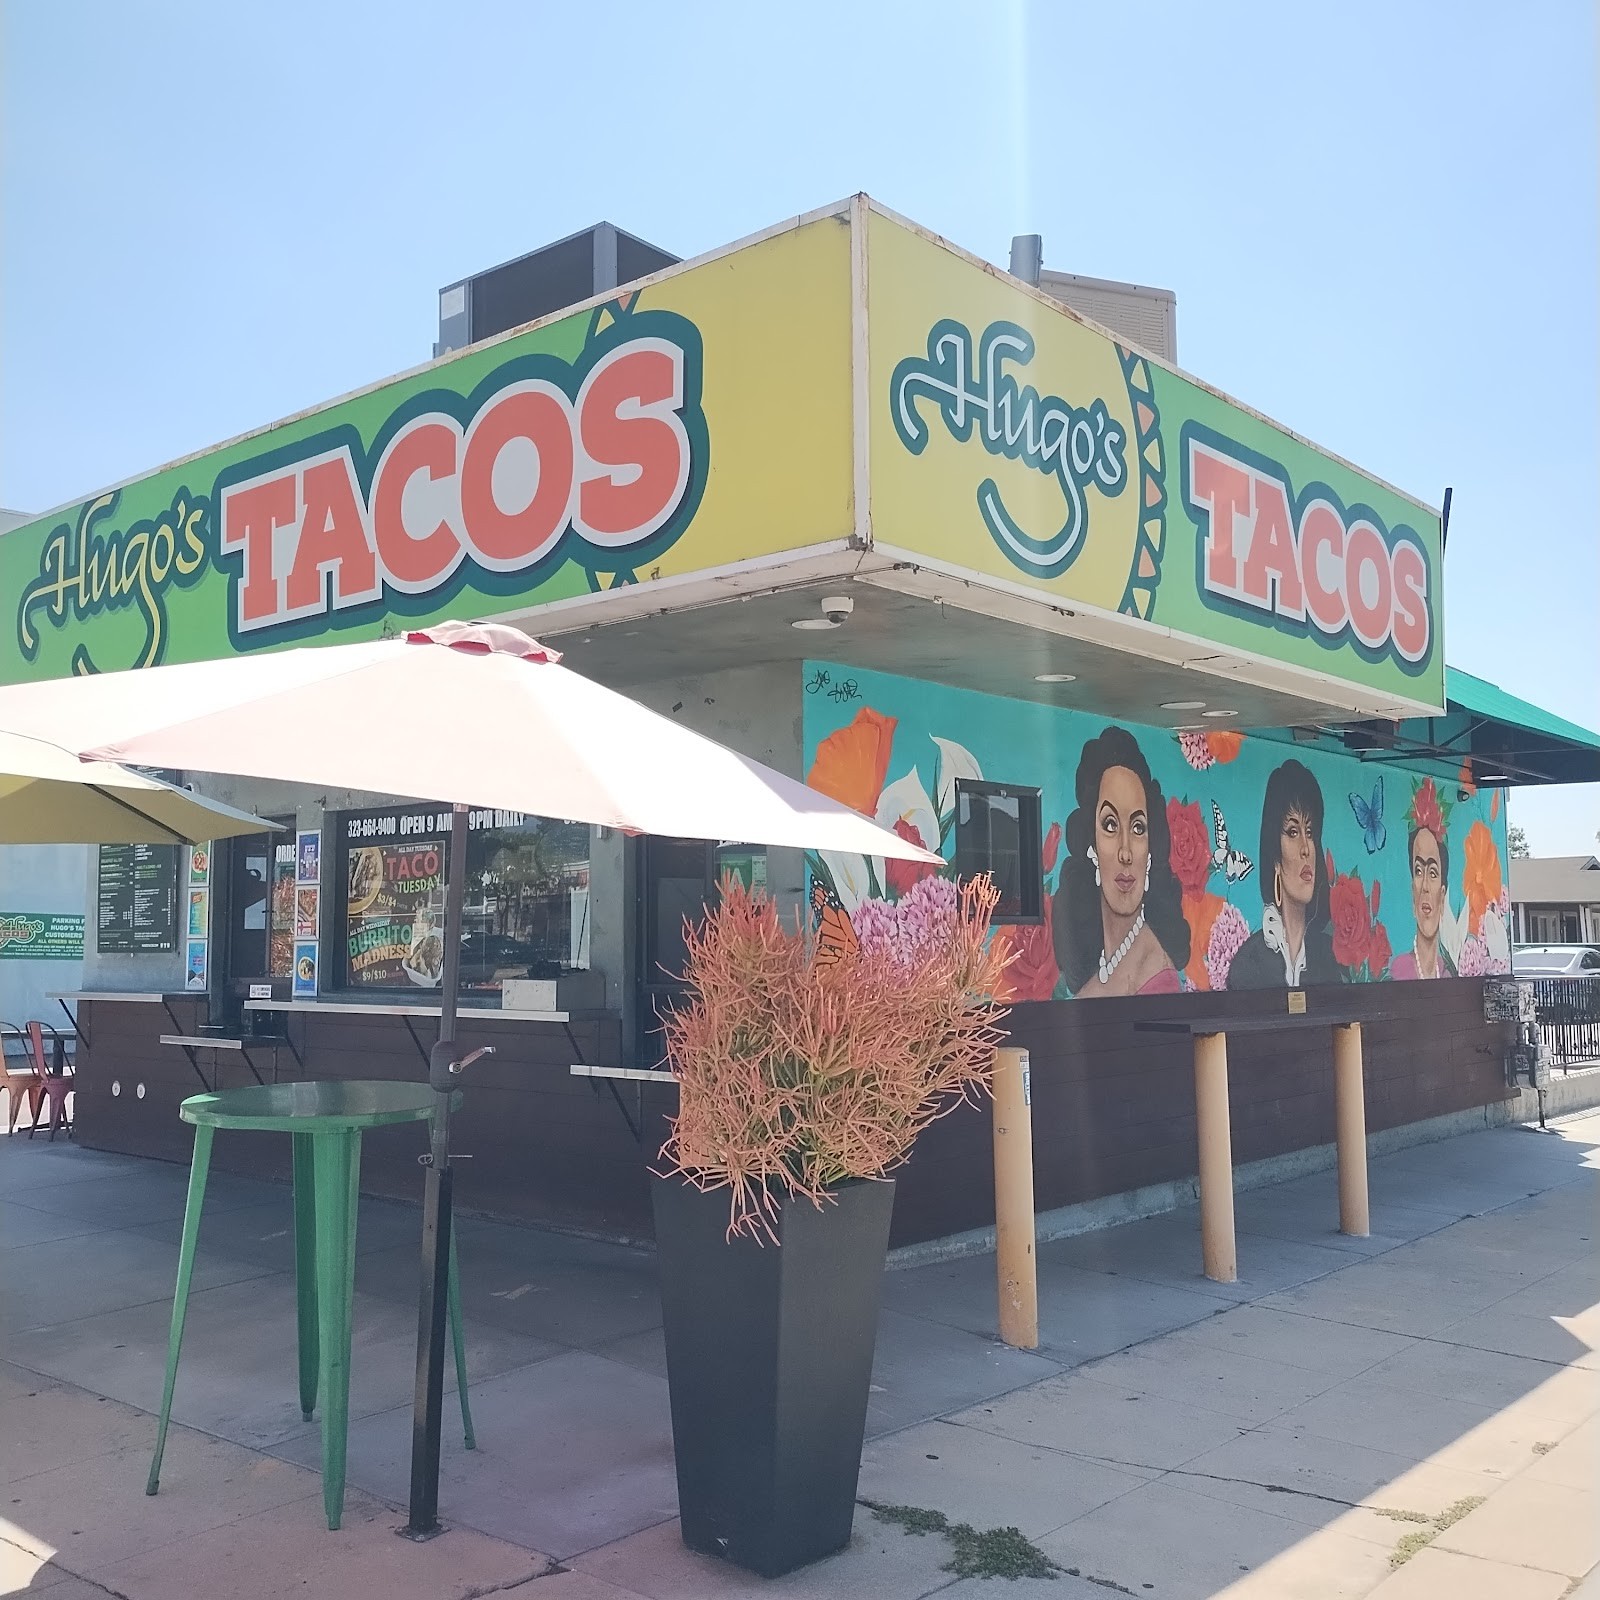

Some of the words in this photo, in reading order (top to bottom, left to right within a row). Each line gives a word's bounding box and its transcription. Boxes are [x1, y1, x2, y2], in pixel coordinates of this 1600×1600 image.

[899, 332, 1122, 566] Hugo's
[220, 337, 691, 632] TACOS
[1189, 437, 1430, 662] TACOS
[20, 492, 206, 670] Hugo's
[347, 817, 396, 838] 323-664-9400
[399, 815, 426, 834] OPEN
[426, 814, 434, 832] 9
[435, 812, 453, 832] AM
[468, 810, 493, 831] 9PM
[494, 809, 525, 828] DAILY
[386, 851, 438, 881] TACO
[398, 873, 441, 894] TUESDAY
[0, 930, 29, 939] COS
[349, 925, 411, 957] BURRITO
[352, 943, 412, 972] MADNESS
[362, 969, 387, 983] $9/$10
